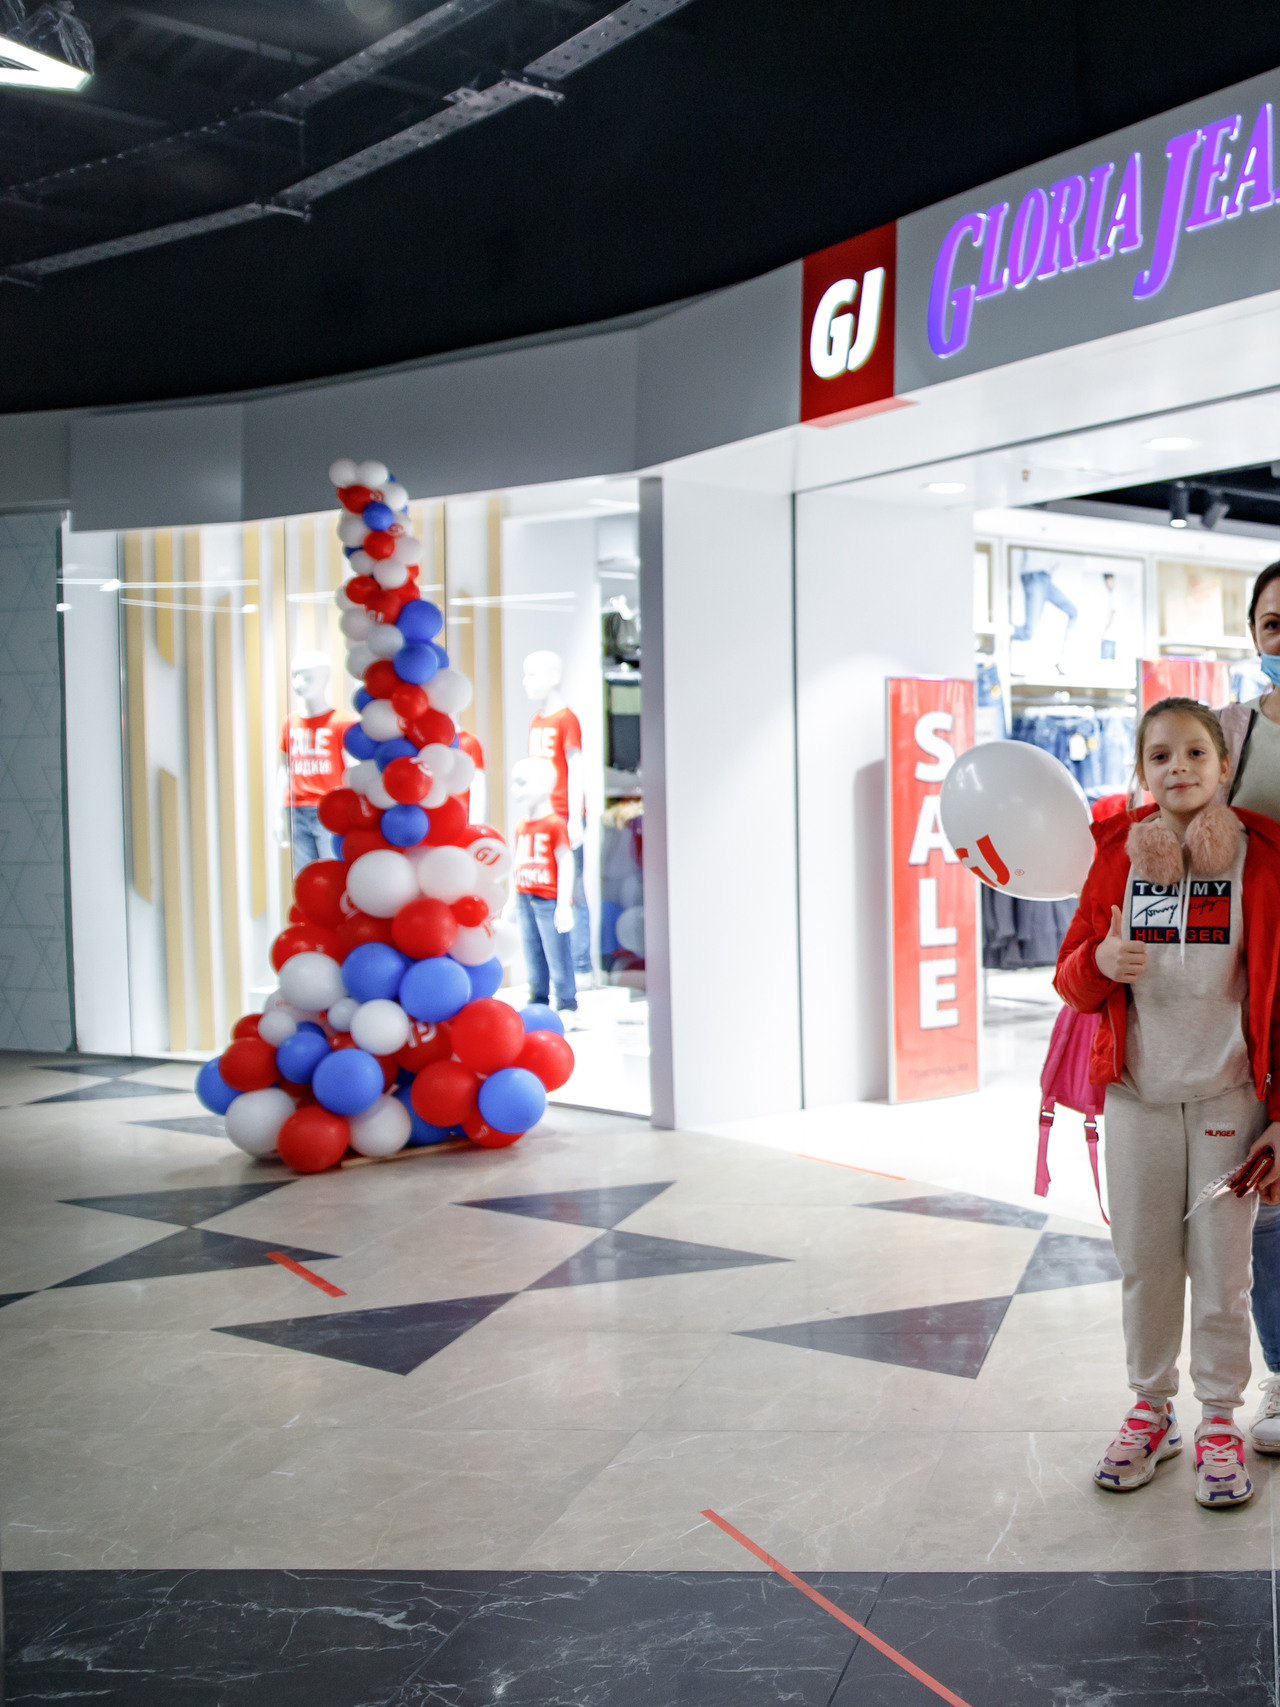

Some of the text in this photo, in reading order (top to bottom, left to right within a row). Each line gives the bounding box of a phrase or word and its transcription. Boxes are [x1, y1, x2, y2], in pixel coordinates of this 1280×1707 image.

[926, 151, 1143, 359] GLORIA
[809, 266, 886, 380] GJ
[474, 846, 501, 866] GJ
[908, 710, 960, 1030] SALE
[1135, 928, 1225, 942] HILFGER
